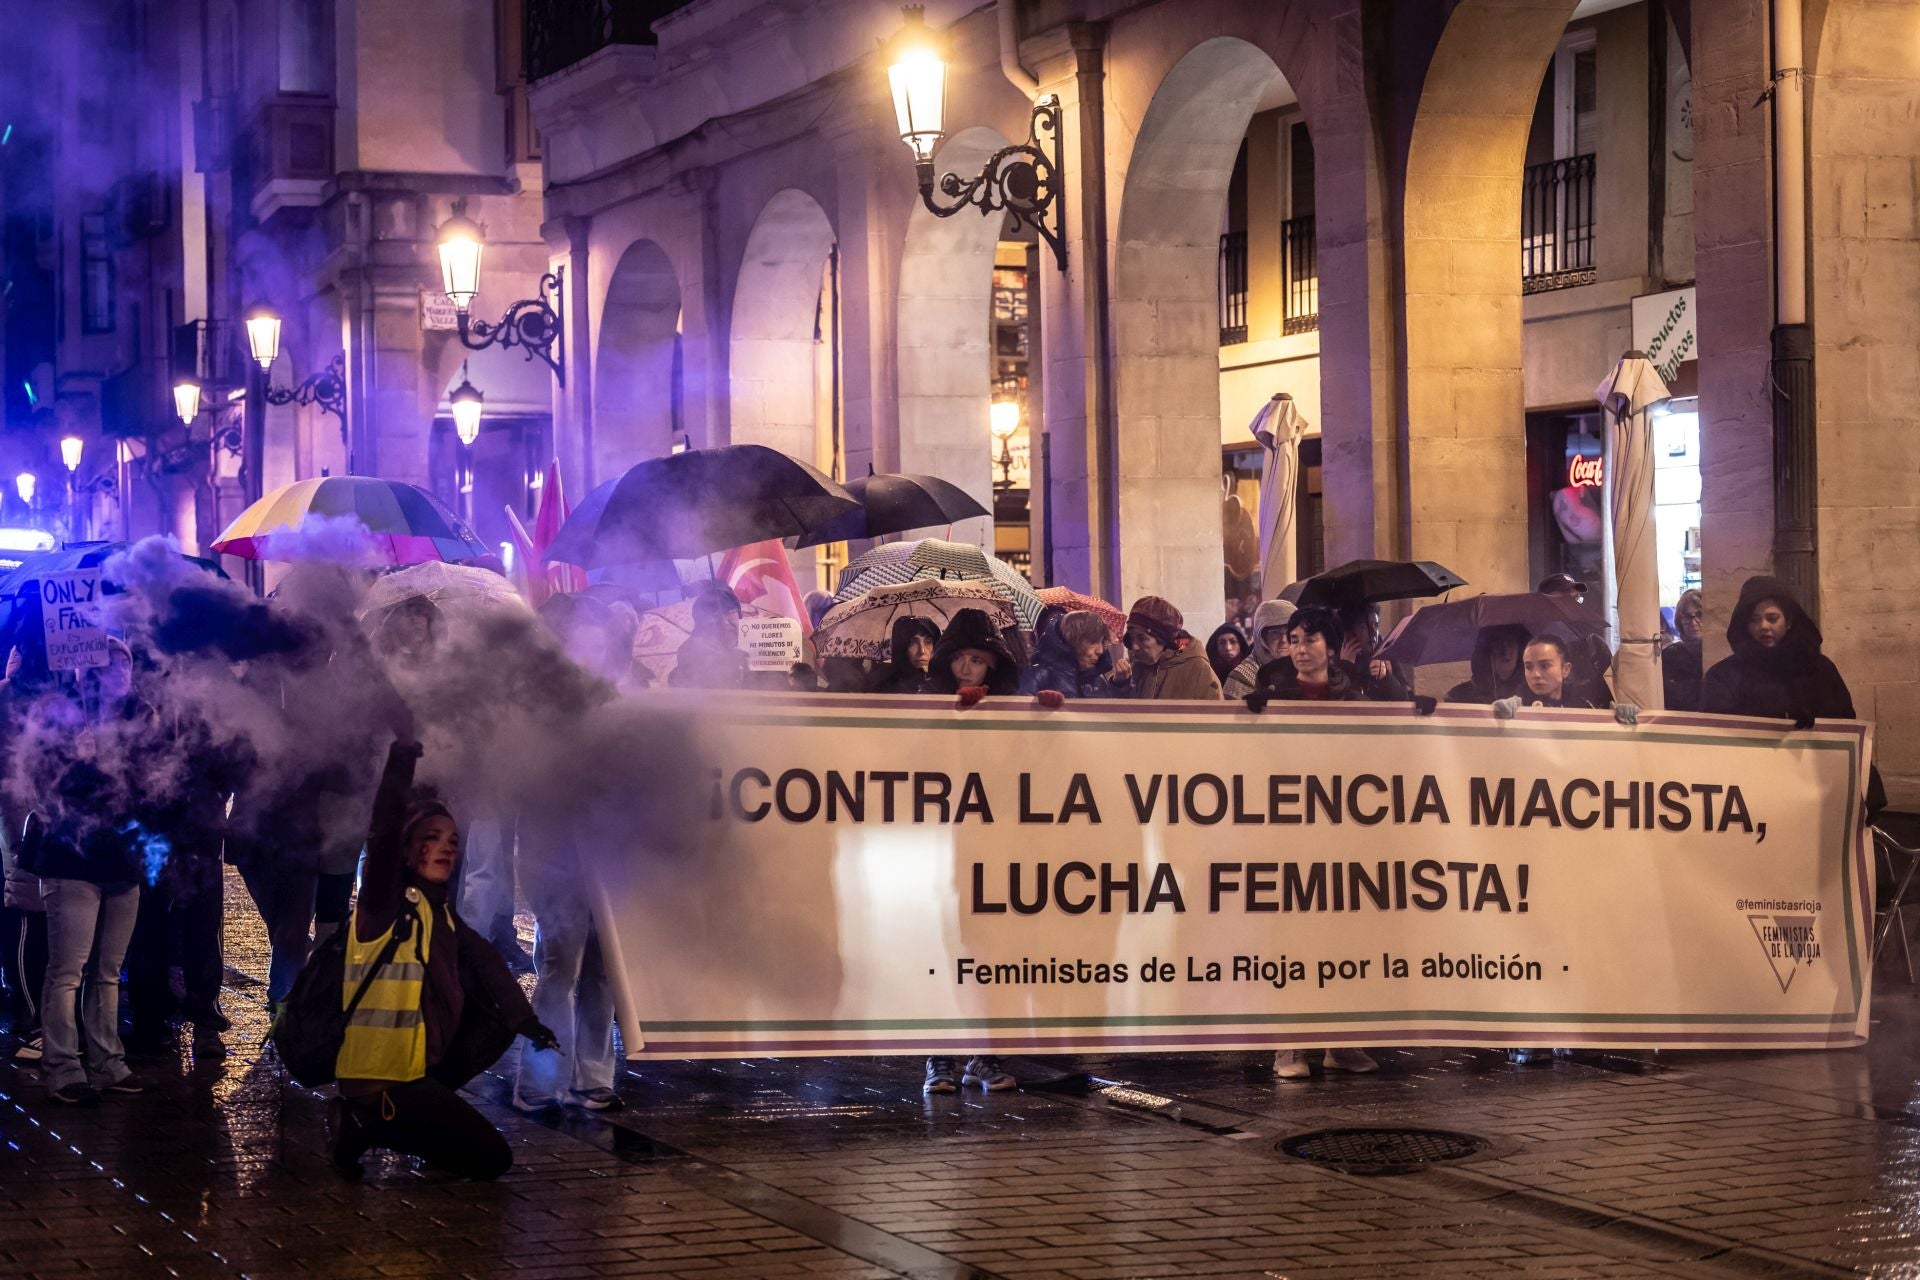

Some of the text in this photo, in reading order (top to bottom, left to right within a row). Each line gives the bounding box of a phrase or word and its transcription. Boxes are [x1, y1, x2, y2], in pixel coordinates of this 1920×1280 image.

[1646, 295, 1687, 361] roductos
[43, 579, 95, 604] ONLY
[761, 622, 791, 630] QUEREMOS
[709, 767, 1768, 845] ¡CONTRA LA VIOLENCIA MACHISTA,
[970, 858, 1531, 916] LUCHA FEMINISTA!
[1735, 899, 1822, 914] @feministasrioja
[1763, 926, 1815, 942] FEMINISTAS
[1771, 943, 1821, 960] DE LA RIOJA
[956, 951, 1543, 989] Feministas de La Rioja por la abolición
